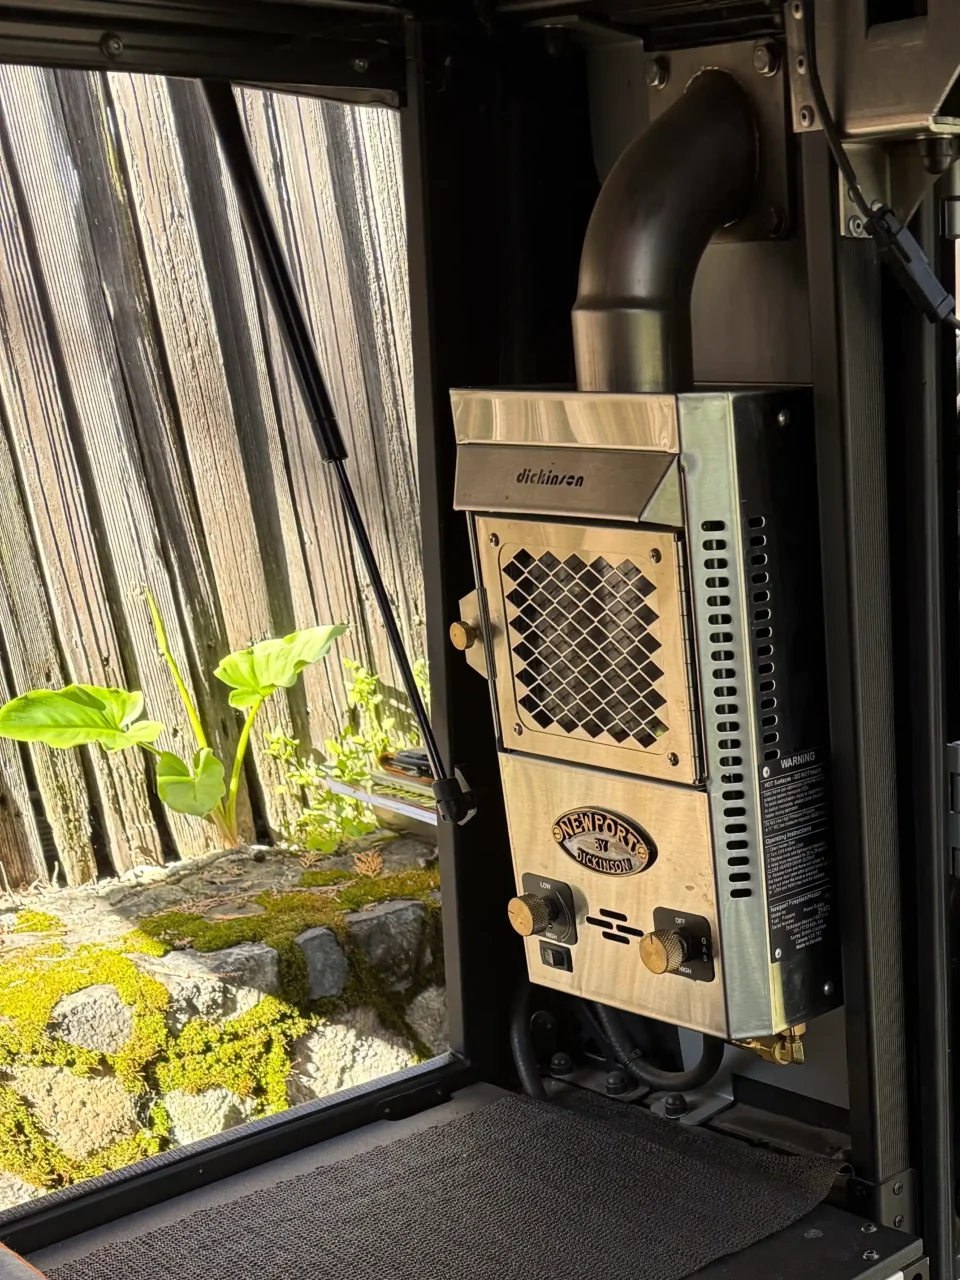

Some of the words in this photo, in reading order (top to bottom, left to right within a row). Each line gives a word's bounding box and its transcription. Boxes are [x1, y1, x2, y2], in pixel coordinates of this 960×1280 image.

[516, 468, 584, 487] dickinson
[780, 751, 816, 769] WARNING
[560, 812, 638, 852] NEWPORT
[594, 839, 608, 852] BY
[576, 849, 631, 872] DICKINSON
[540, 881, 551, 890] LOW
[675, 917, 686, 925] OFF
